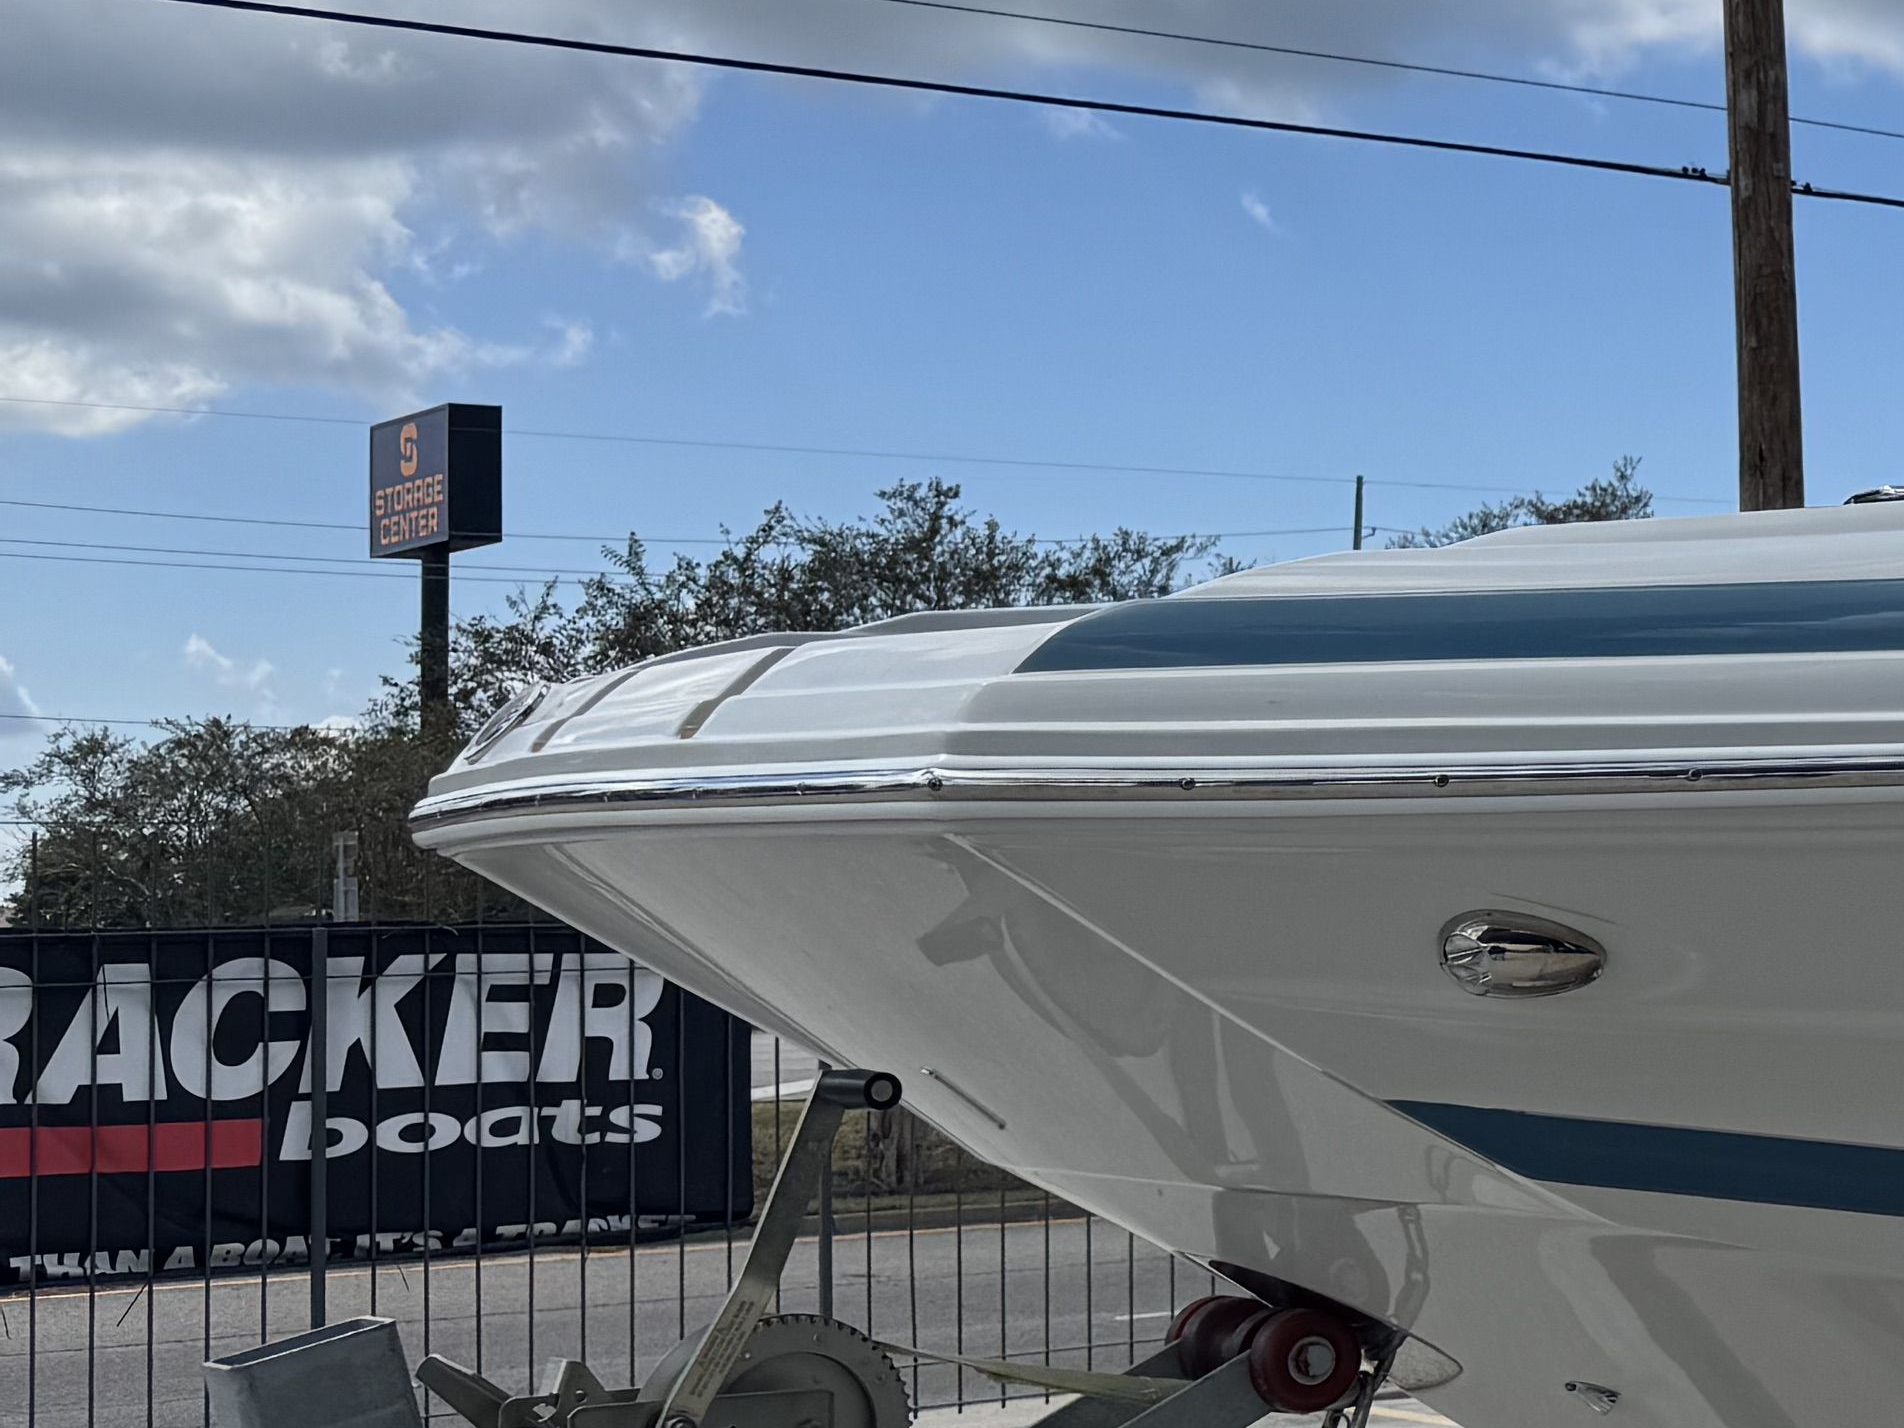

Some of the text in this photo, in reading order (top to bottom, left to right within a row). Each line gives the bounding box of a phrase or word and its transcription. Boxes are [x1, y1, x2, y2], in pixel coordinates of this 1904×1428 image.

[374, 474, 444, 517] STORAGE
[380, 506, 438, 546] CENTER
[0, 952, 664, 1106] ACKER
[278, 1098, 664, 1162] boats
[9, 1248, 156, 1282] THAN
[162, 1245, 197, 1271] A
